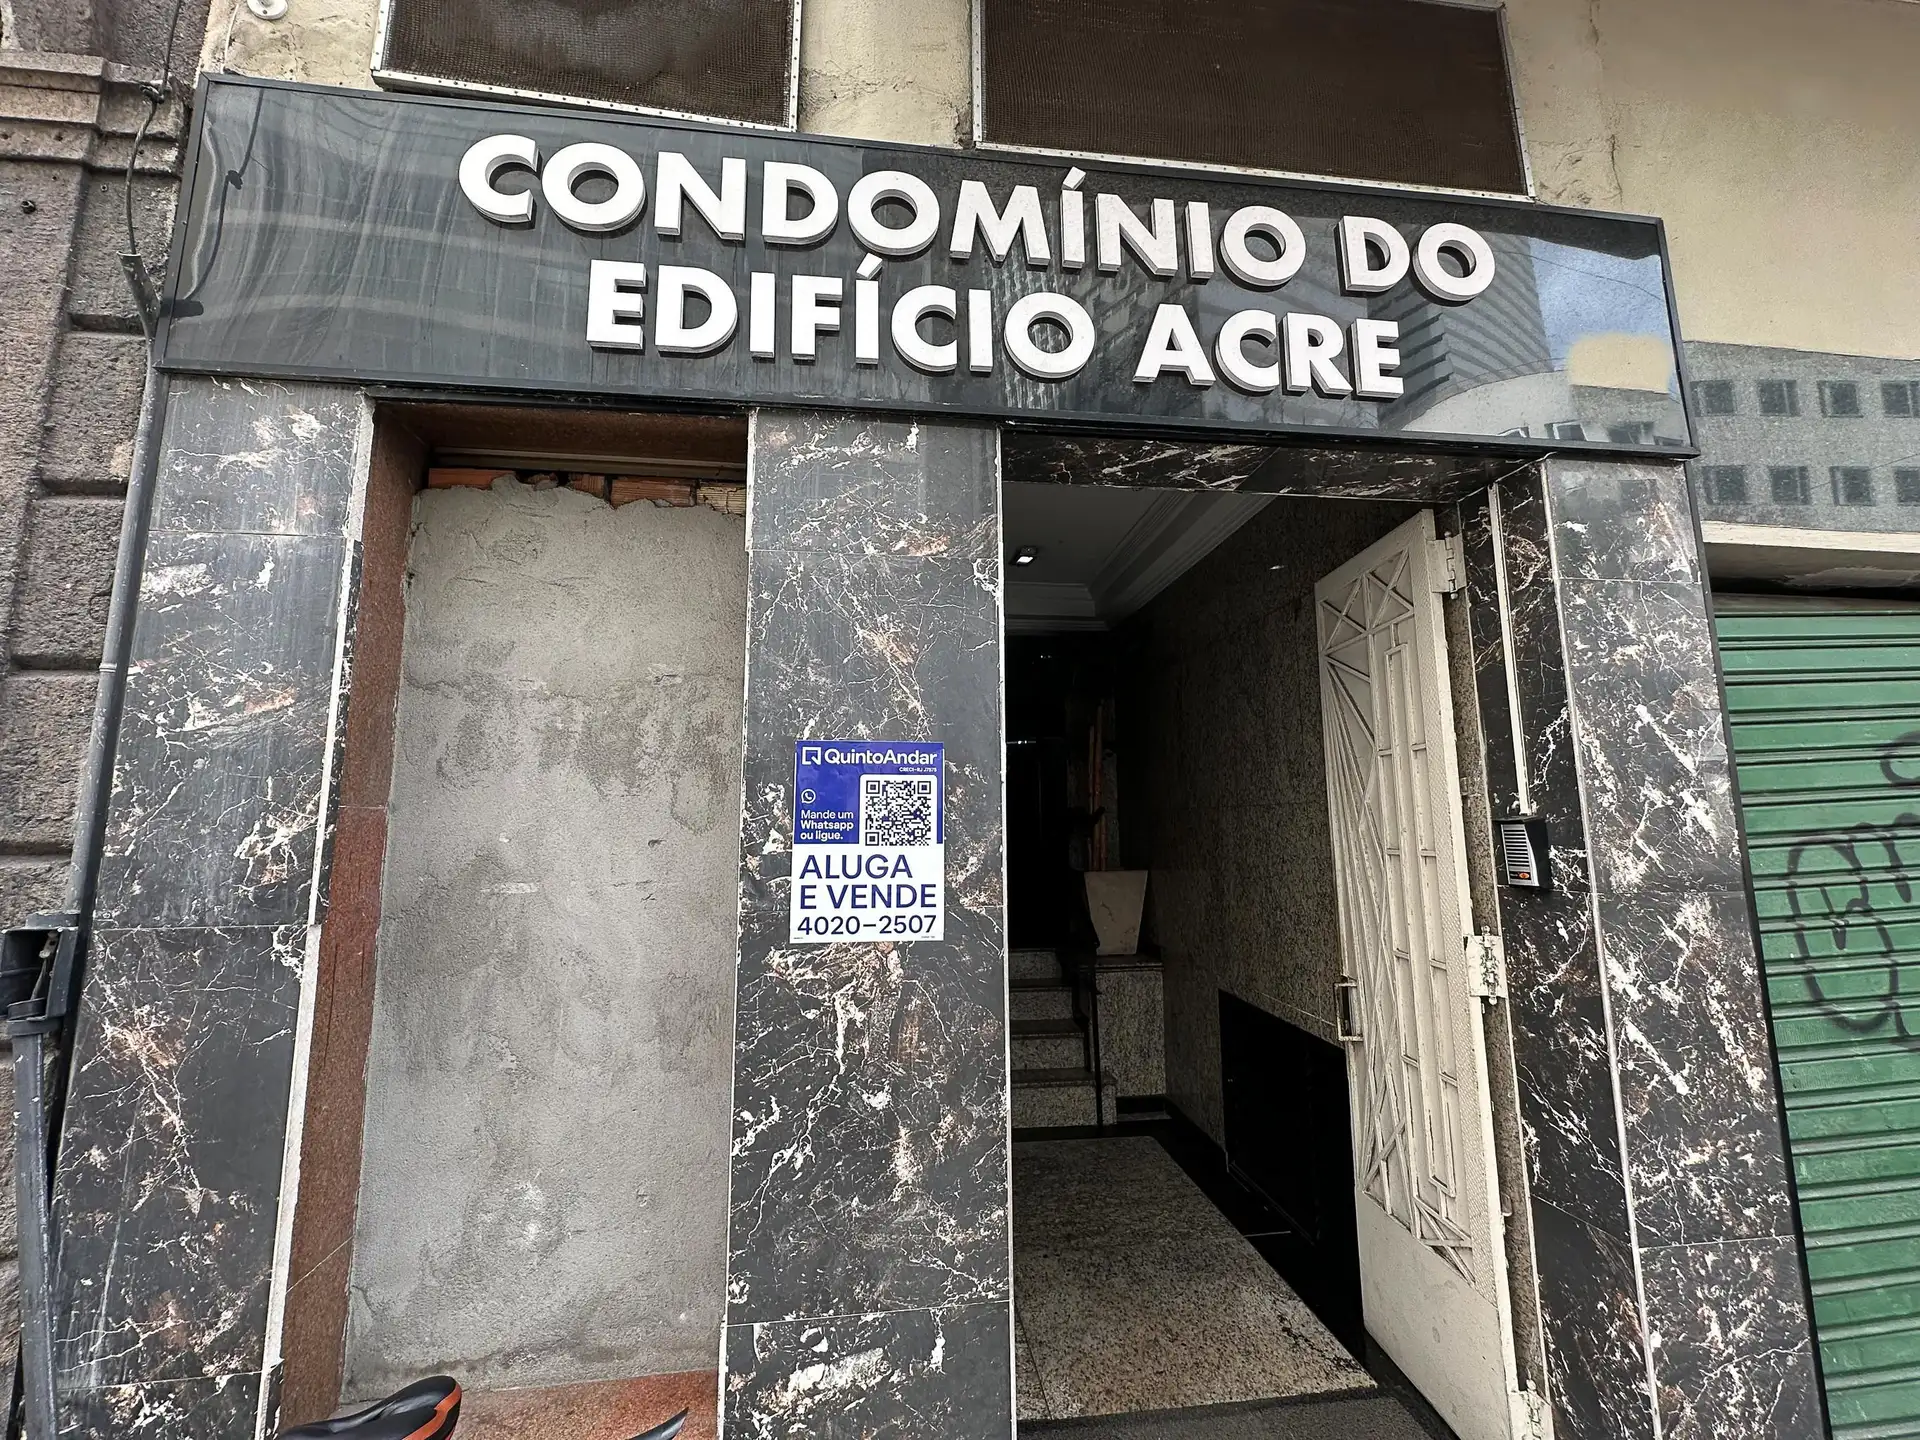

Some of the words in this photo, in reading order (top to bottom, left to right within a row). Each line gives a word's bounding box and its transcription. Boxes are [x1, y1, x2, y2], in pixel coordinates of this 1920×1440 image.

[457, 133, 1307, 287] CONDOMÍNIO
[1338, 214, 1496, 301] DO
[586, 252, 1095, 379] EDIFÍCIO
[1133, 303, 1404, 399] ACRE
[824, 749, 937, 765] QuintoAndar
[801, 809, 835, 819] Mande
[838, 811, 854, 819] um
[801, 819, 854, 831] Whatsapp
[800, 832, 814, 840] ou
[815, 829, 843, 842] ligue.
[799, 854, 913, 880] ALUGA
[800, 884, 817, 909] E
[826, 884, 937, 909] VENDE
[797, 915, 937, 935] 4020-2507
